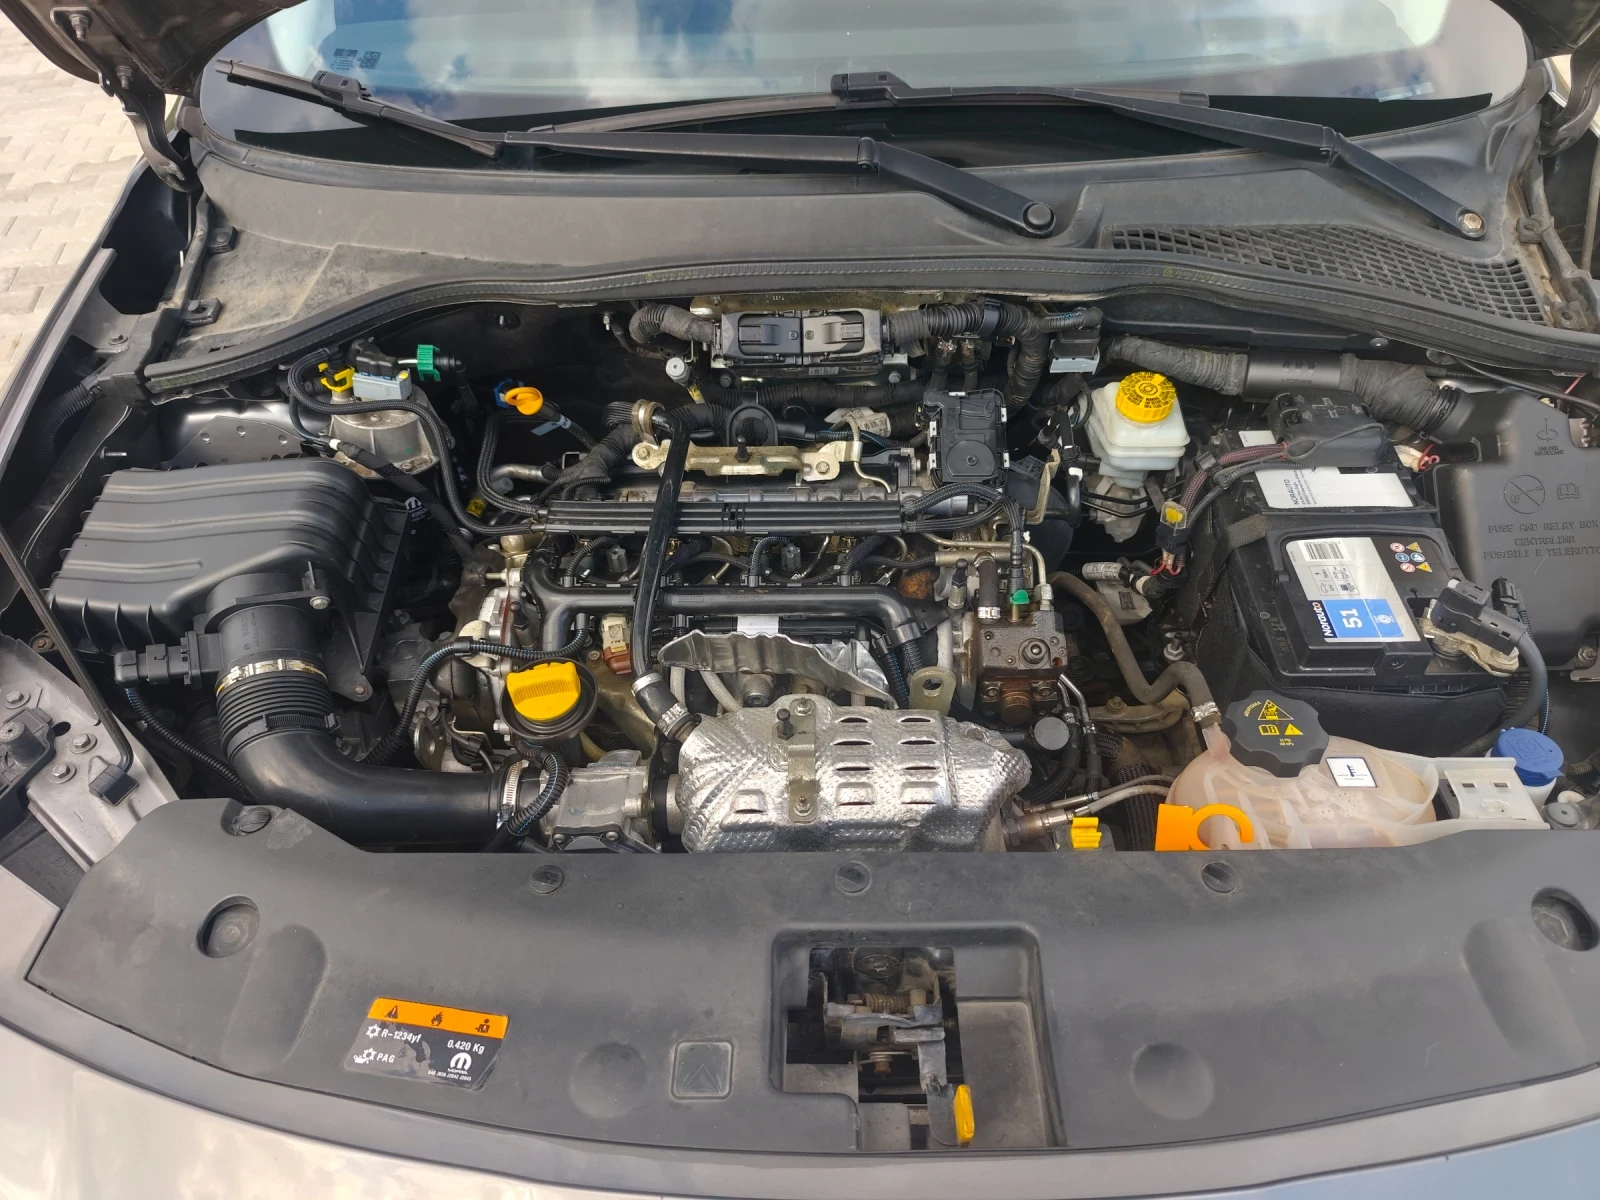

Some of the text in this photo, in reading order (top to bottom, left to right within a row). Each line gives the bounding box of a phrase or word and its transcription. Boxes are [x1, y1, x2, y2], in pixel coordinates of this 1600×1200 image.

[1488, 519, 1599, 533] FUSE AND RELAY BOX
[1514, 536, 1576, 546] CENTRALINA
[1311, 601, 1334, 637] Norauto
[1339, 608, 1363, 628] 51
[381, 1028, 422, 1044] R-1234yf
[447, 1039, 485, 1055] 0.420 Kg
[376, 1052, 395, 1064] PAG
